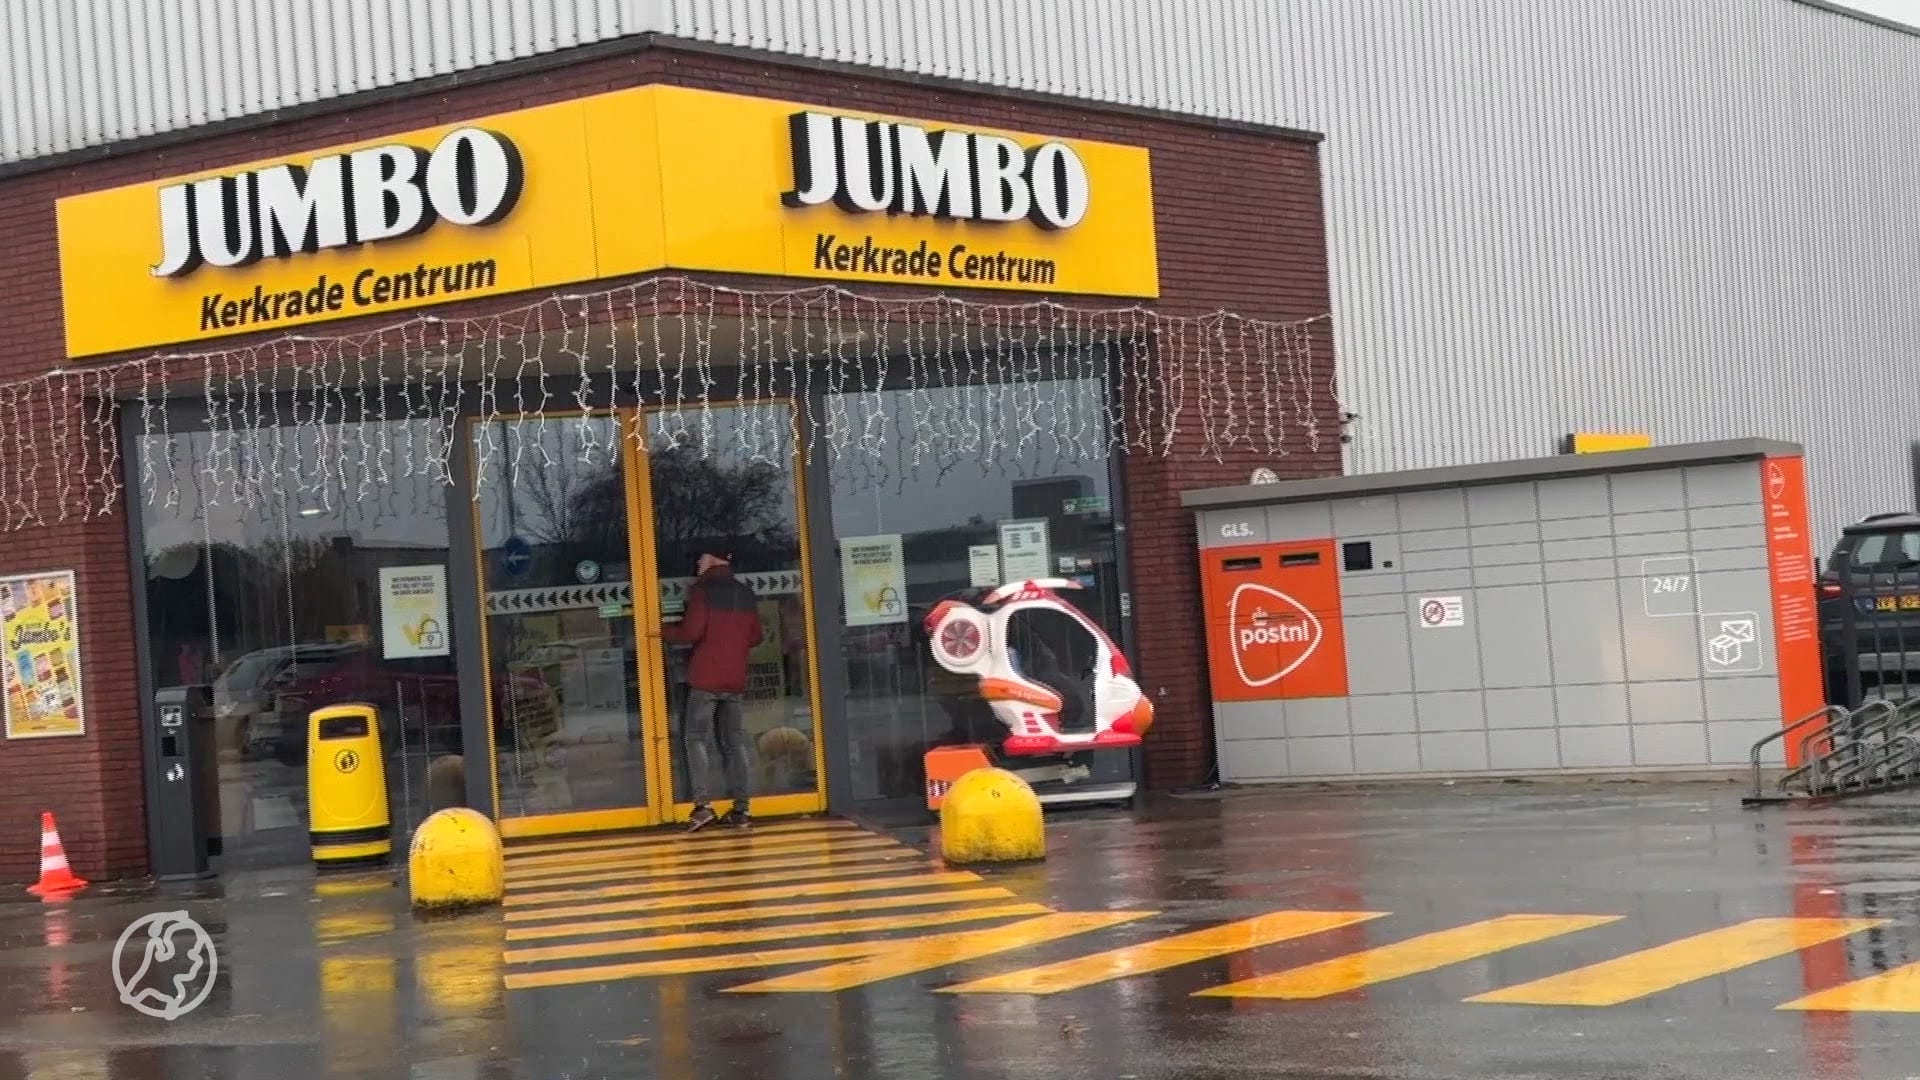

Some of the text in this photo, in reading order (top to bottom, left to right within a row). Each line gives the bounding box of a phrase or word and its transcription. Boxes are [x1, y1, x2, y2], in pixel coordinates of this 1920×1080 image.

[781, 110, 1090, 230] JUMBO
[150, 126, 522, 278] JUMBO
[814, 232, 1056, 284] Kerkrade Centrum
[199, 258, 497, 331] Kerkrade Centrum
[1652, 576, 1690, 595] 24/7
[1240, 619, 1310, 651] postnl
